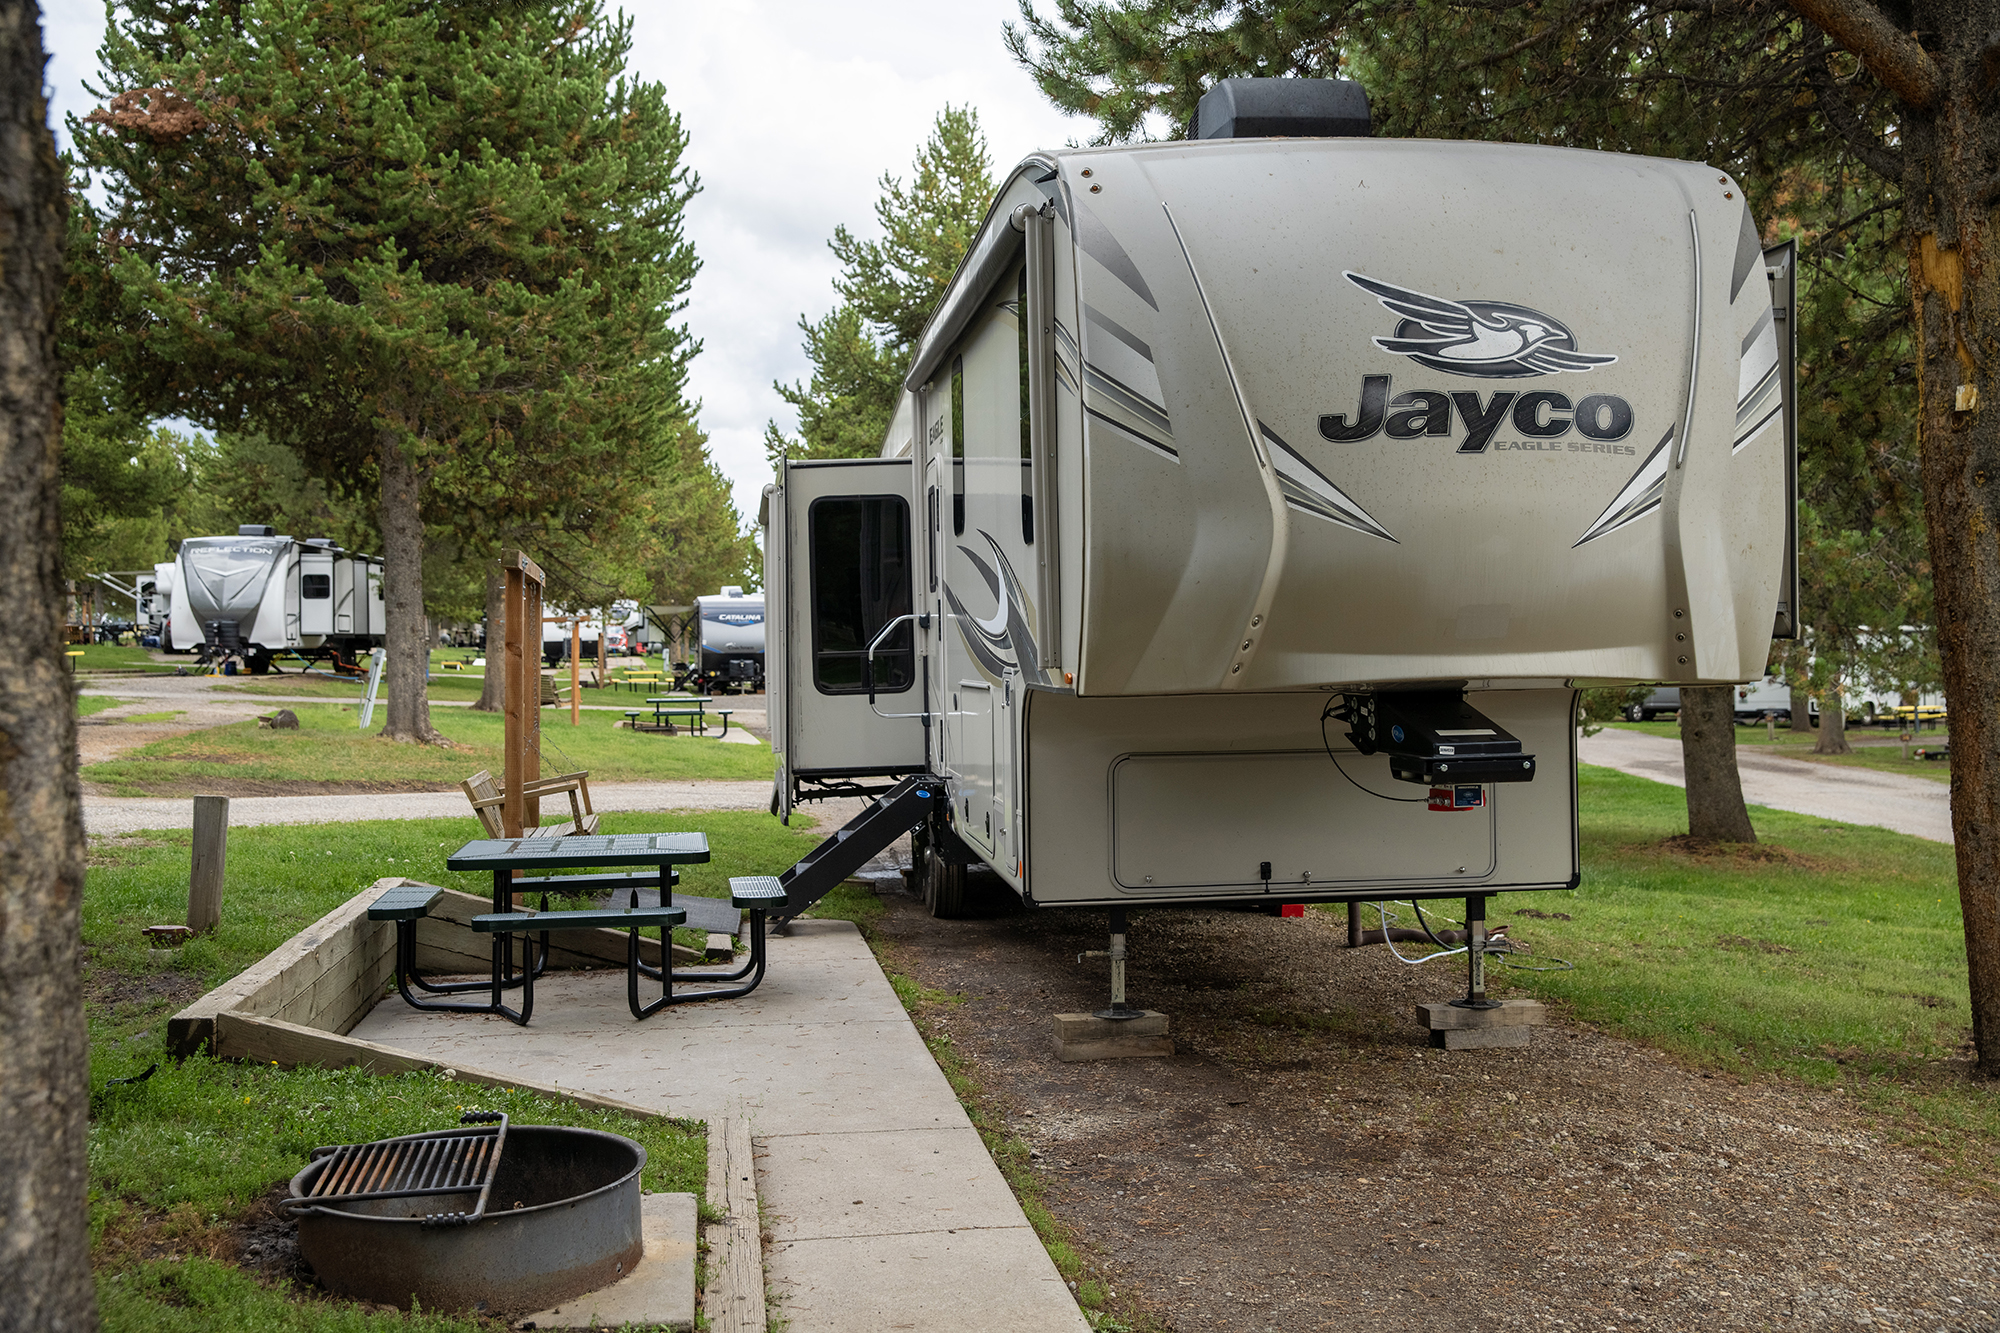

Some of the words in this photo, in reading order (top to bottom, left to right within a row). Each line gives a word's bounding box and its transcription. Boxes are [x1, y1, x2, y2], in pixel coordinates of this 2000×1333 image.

[1317, 373, 1634, 454] Jayco
[1494, 441, 1563, 451] EAGLE
[1567, 442, 1636, 456] SERIES
[190, 546, 274, 555] REFLECTION
